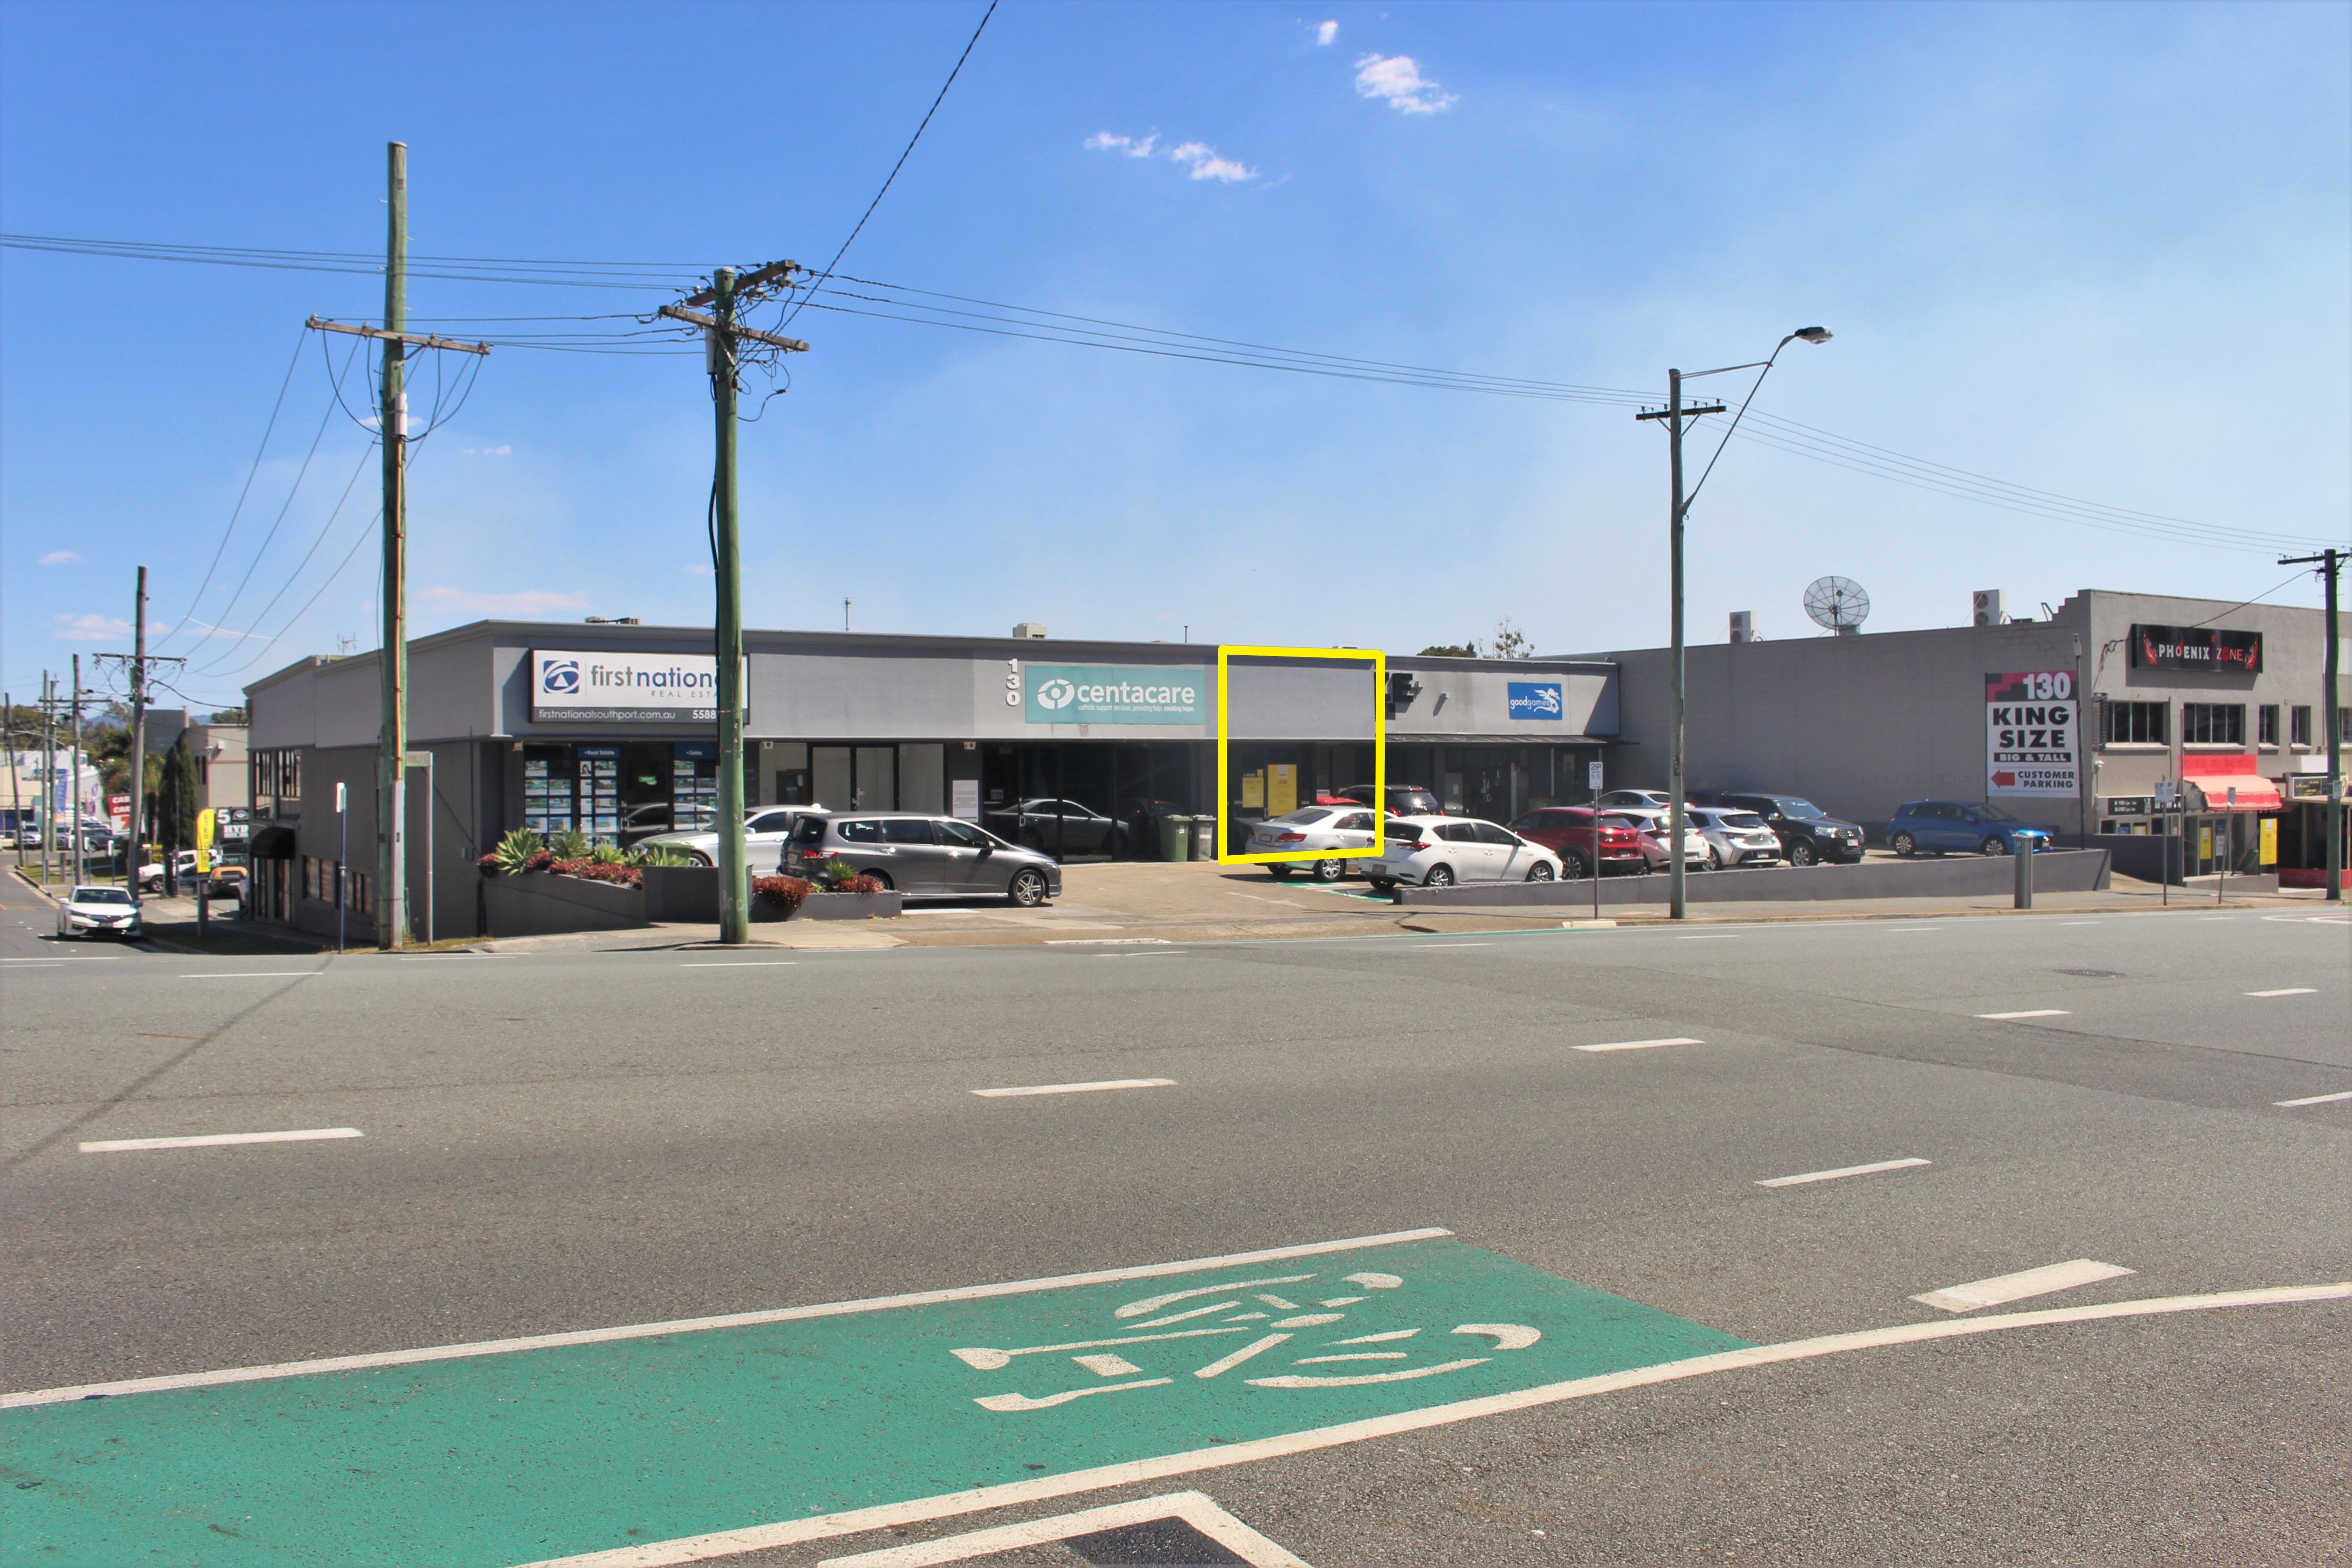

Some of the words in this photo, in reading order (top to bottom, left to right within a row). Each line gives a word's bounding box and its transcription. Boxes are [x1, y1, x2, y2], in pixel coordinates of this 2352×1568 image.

[2158, 644, 2210, 660] PHOENIX
[2216, 647, 2244, 662] ZONE
[591, 665, 633, 686] first
[637, 667, 717, 687] nation
[1006, 658, 1020, 706] 130
[2022, 671, 2071, 700] 130
[1077, 681, 1195, 704] centacare
[1510, 696, 1550, 710] goodgames
[539, 710, 676, 720] firstnationalsouthport.com.au
[692, 710, 716, 719] 5588
[1992, 706, 2070, 726] KING
[1999, 730, 2065, 749] SIZE
[2017, 771, 2075, 779] CUSTOMER
[2023, 780, 2073, 788] PARKING
